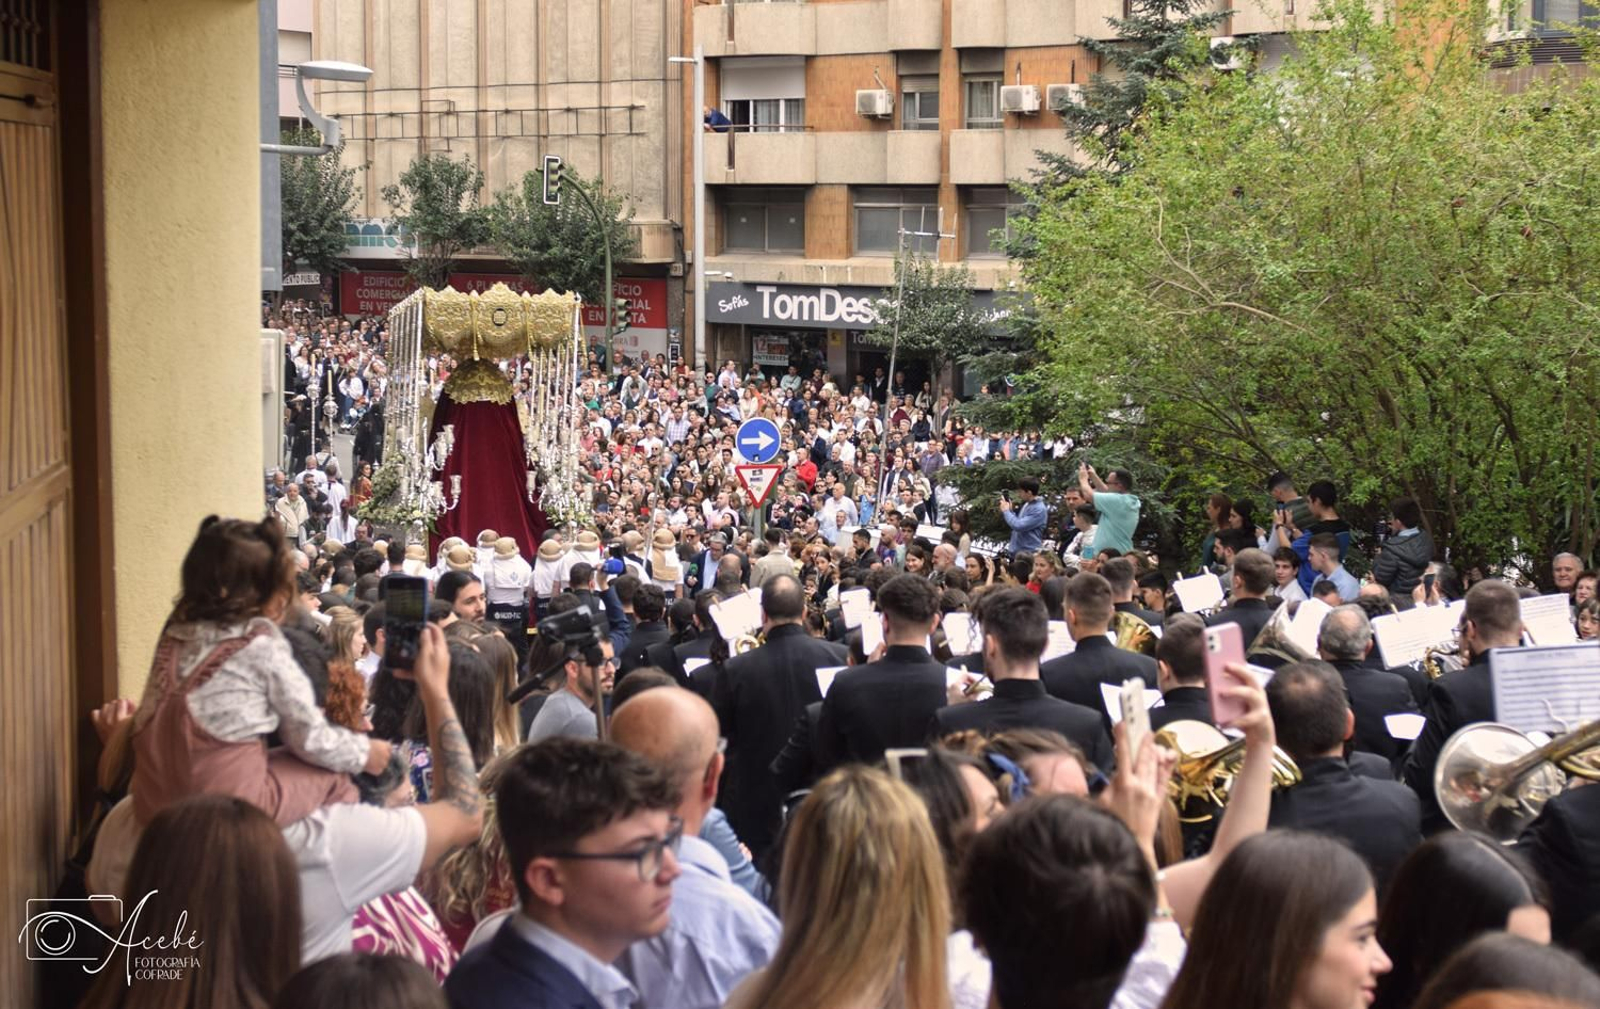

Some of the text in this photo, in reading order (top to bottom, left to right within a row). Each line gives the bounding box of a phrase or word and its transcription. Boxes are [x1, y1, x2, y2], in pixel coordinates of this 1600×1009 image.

[363, 276, 405, 288] EDIFICIO
[466, 280, 473, 290] 6
[360, 301, 373, 311] EN
[718, 294, 750, 314] Sofás
[588, 310, 604, 321] EN
